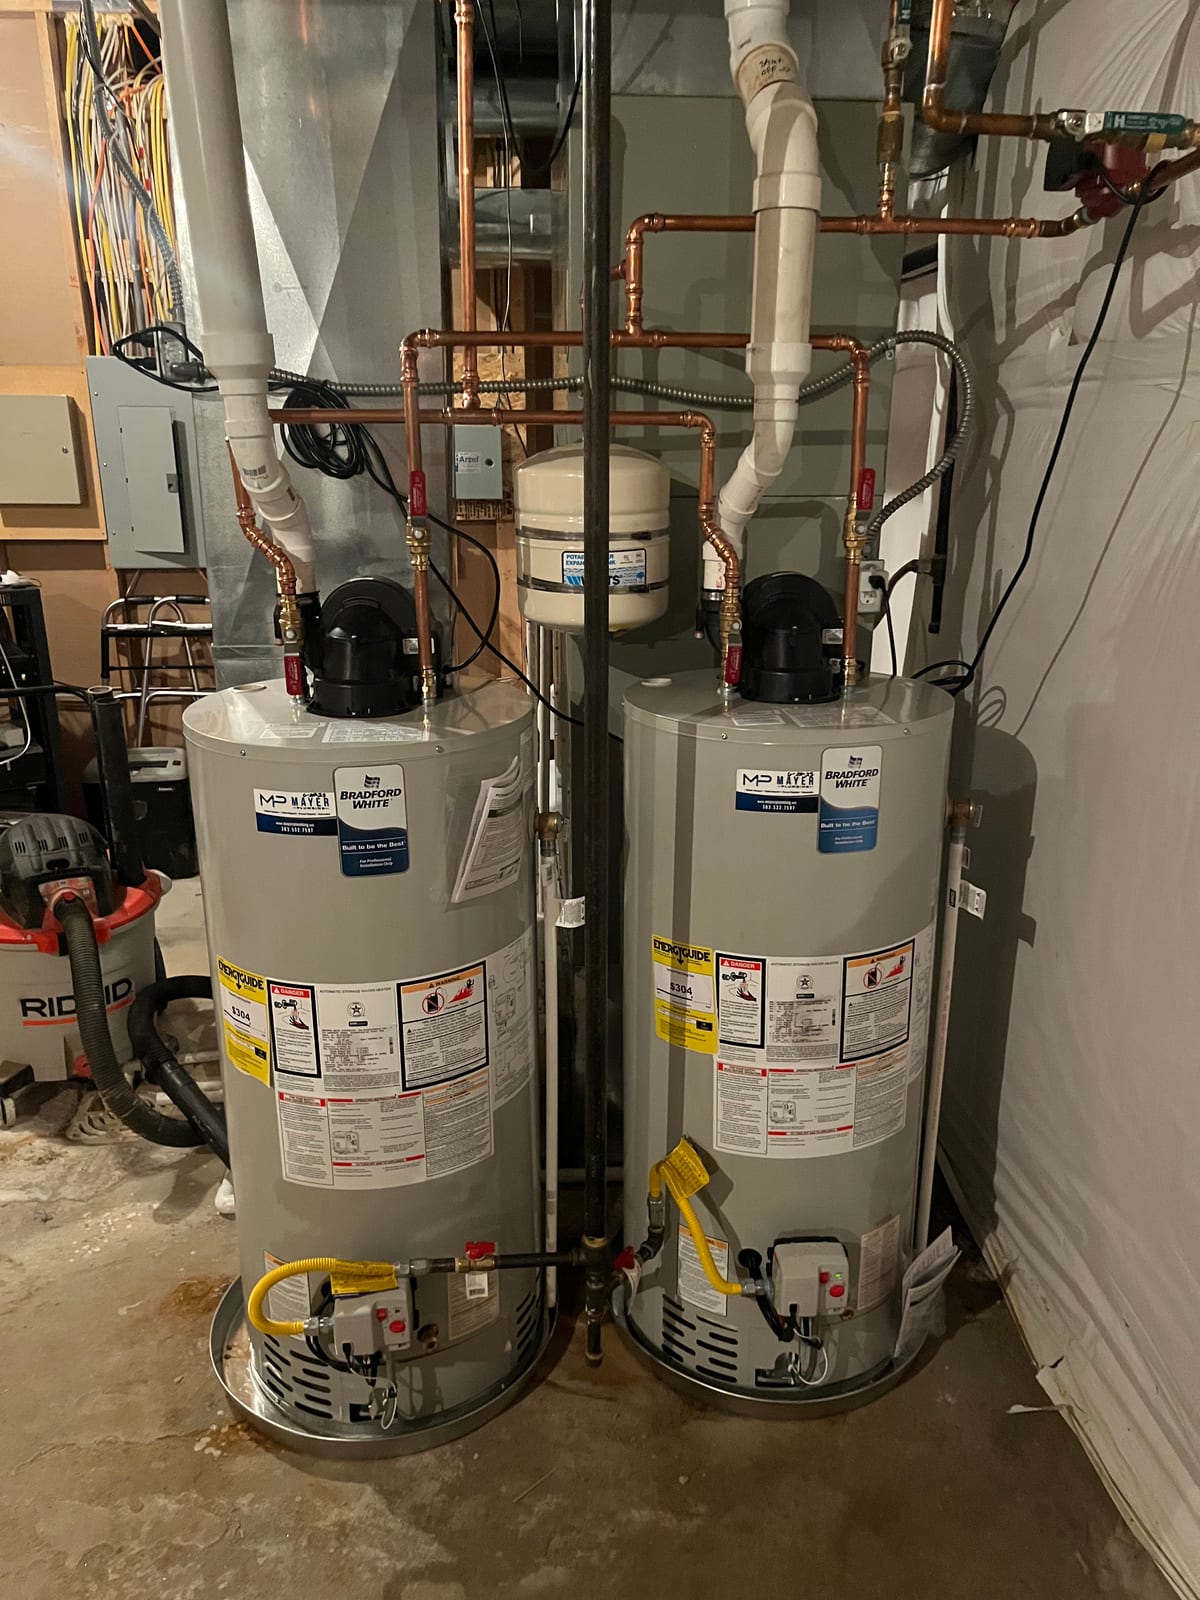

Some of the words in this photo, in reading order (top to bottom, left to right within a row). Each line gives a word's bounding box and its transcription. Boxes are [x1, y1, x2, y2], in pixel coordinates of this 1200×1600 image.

[743, 773, 772, 787] MP
[776, 775, 814, 786] MAYER
[825, 768, 879, 780] BRADFORD
[835, 778, 868, 788] WHITE
[340, 788, 402, 800] BRADFORD
[259, 793, 287, 808] MP
[291, 796, 330, 807] MAYER
[352, 799, 389, 810] WHITE
[730, 961, 756, 969] DANGER
[280, 987, 305, 997] DANGER
[670, 982, 693, 996] $304
[20, 978, 134, 1018] RIDID
[231, 1005, 251, 1022] $304
